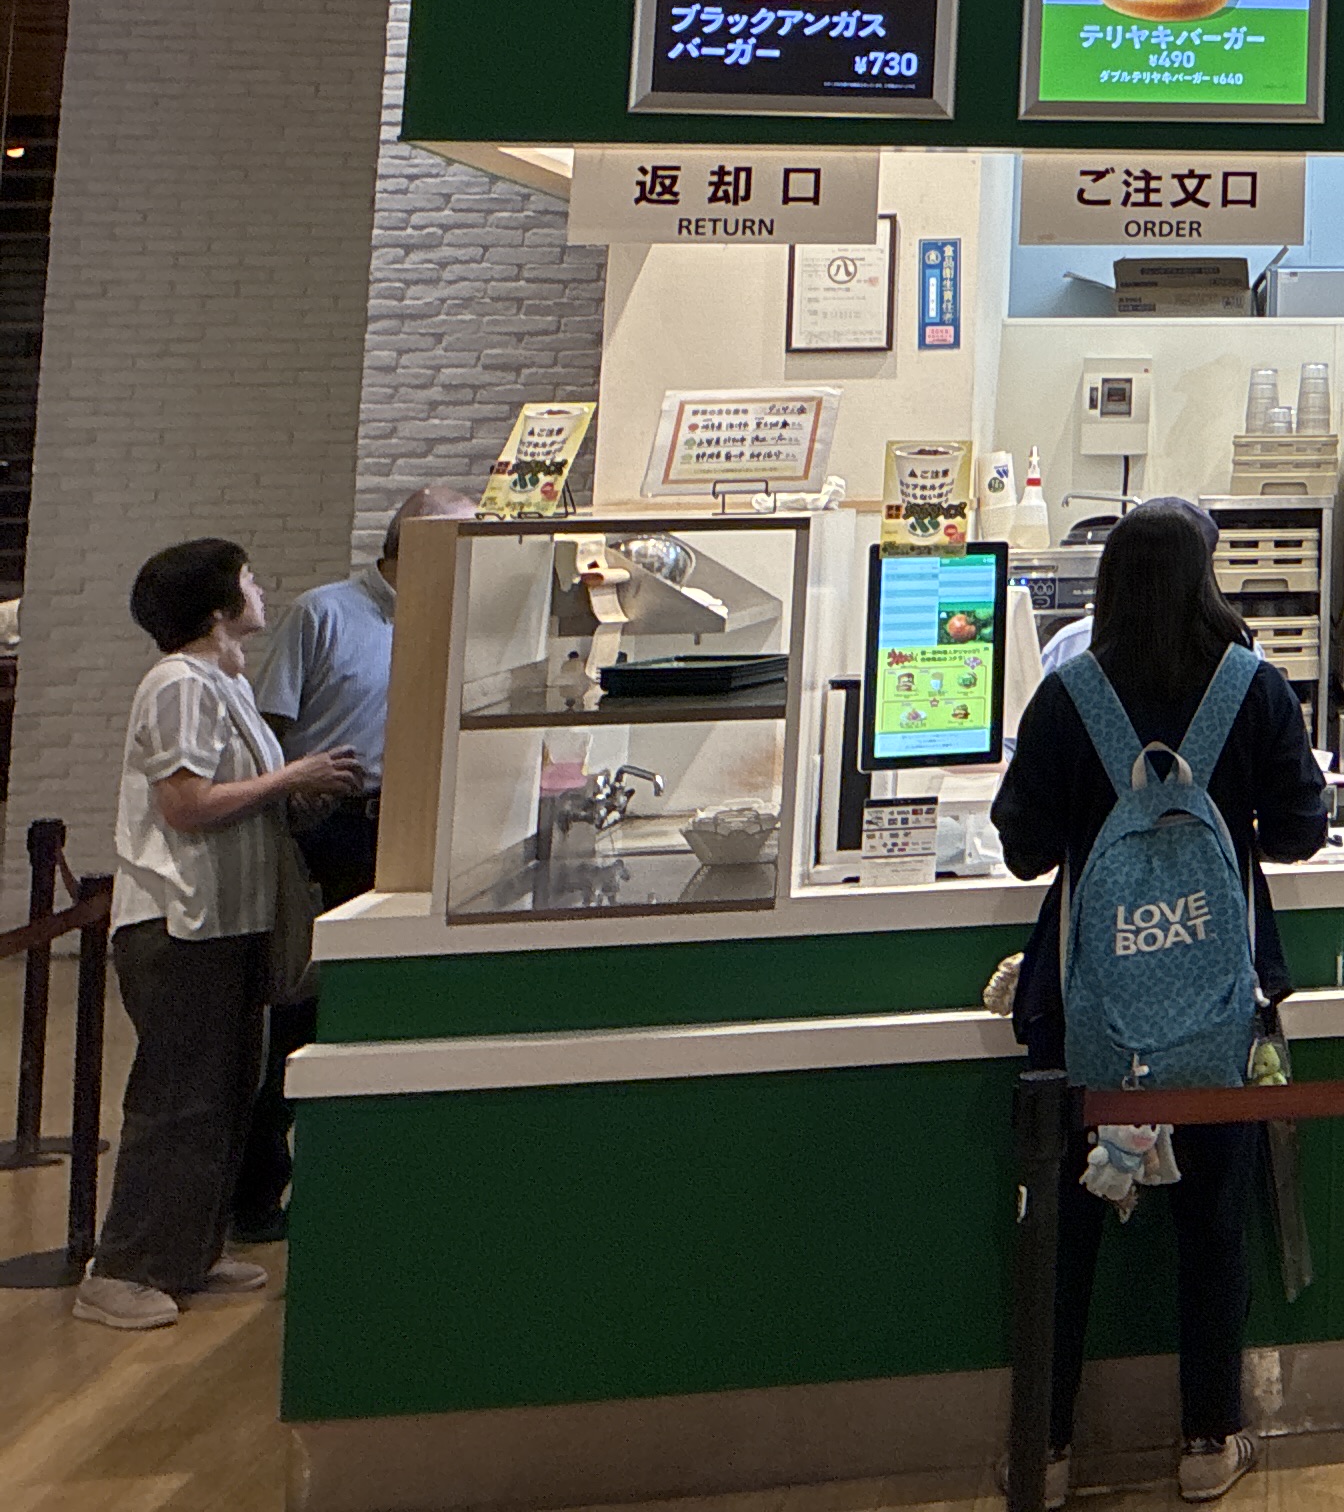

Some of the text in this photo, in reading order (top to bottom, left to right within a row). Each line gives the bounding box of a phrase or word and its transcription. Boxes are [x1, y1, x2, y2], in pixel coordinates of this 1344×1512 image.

[671, 3, 886, 38] ブラックアンガス
[667, 37, 781, 66] バーガー
[1079, 25, 1265, 49] テリヤキバーガー
[854, 51, 919, 76] ¥730
[1149, 51, 1196, 68] ¥490
[634, 164, 823, 208] 返却口
[1074, 167, 1259, 209] ご注文口
[677, 217, 775, 237] RETURN
[1124, 220, 1203, 239] ORDER
[1115, 890, 1211, 932] LOVE
[1114, 915, 1213, 957] BOAT
